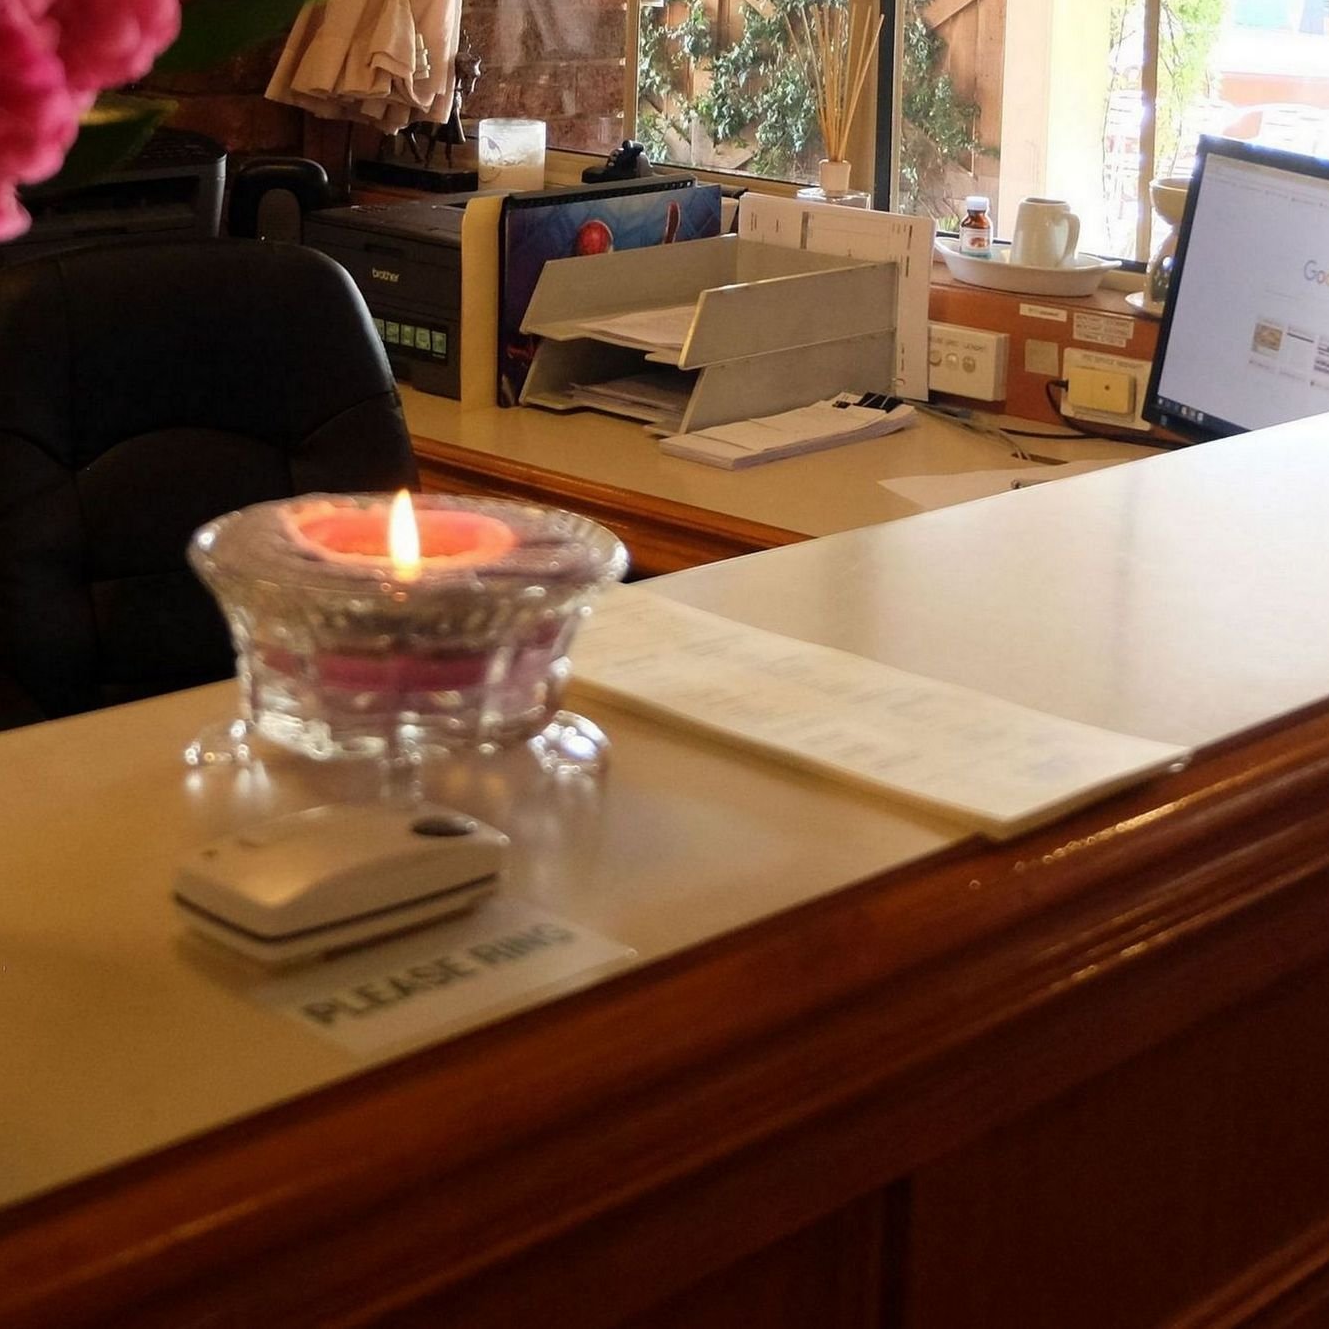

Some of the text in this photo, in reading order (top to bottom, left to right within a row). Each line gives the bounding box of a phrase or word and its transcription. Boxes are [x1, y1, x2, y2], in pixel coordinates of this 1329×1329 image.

[372, 267, 400, 283] brother
[303, 922, 574, 1027] PLEASE RING
